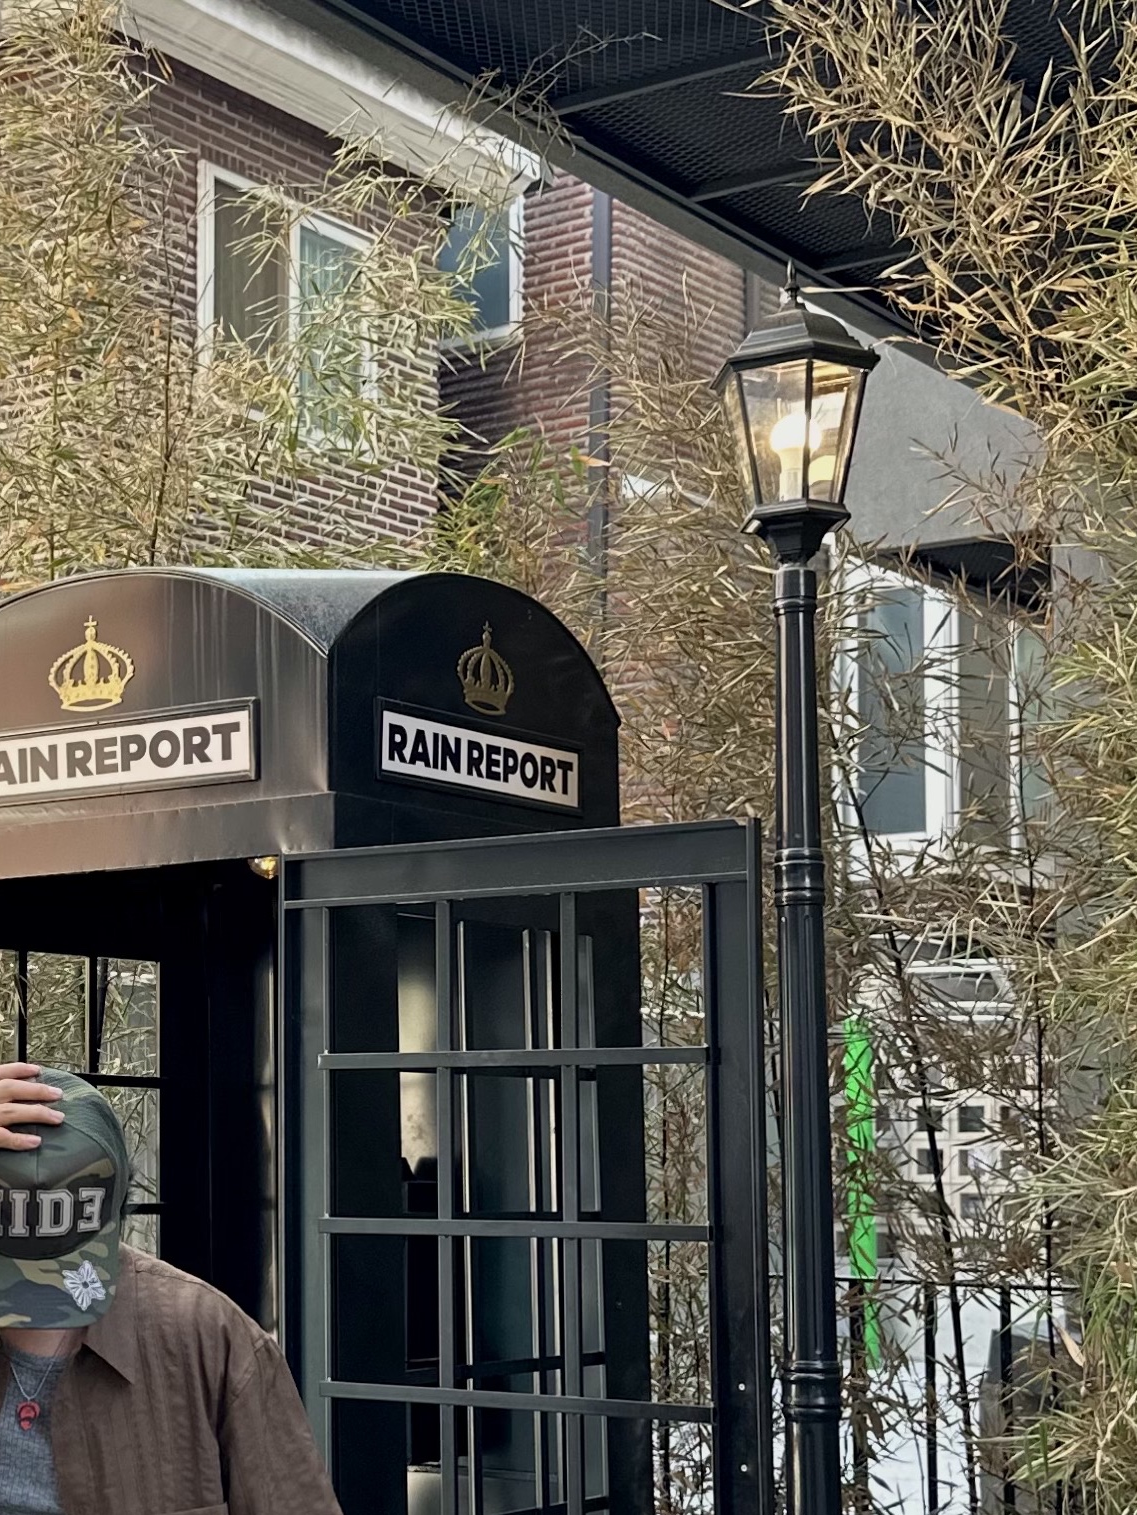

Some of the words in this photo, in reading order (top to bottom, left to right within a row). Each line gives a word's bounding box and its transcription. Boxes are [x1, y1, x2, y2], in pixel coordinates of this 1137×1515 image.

[66, 721, 241, 779] REPORT
[388, 723, 462, 774] RAIN
[467, 739, 574, 796] REPORT
